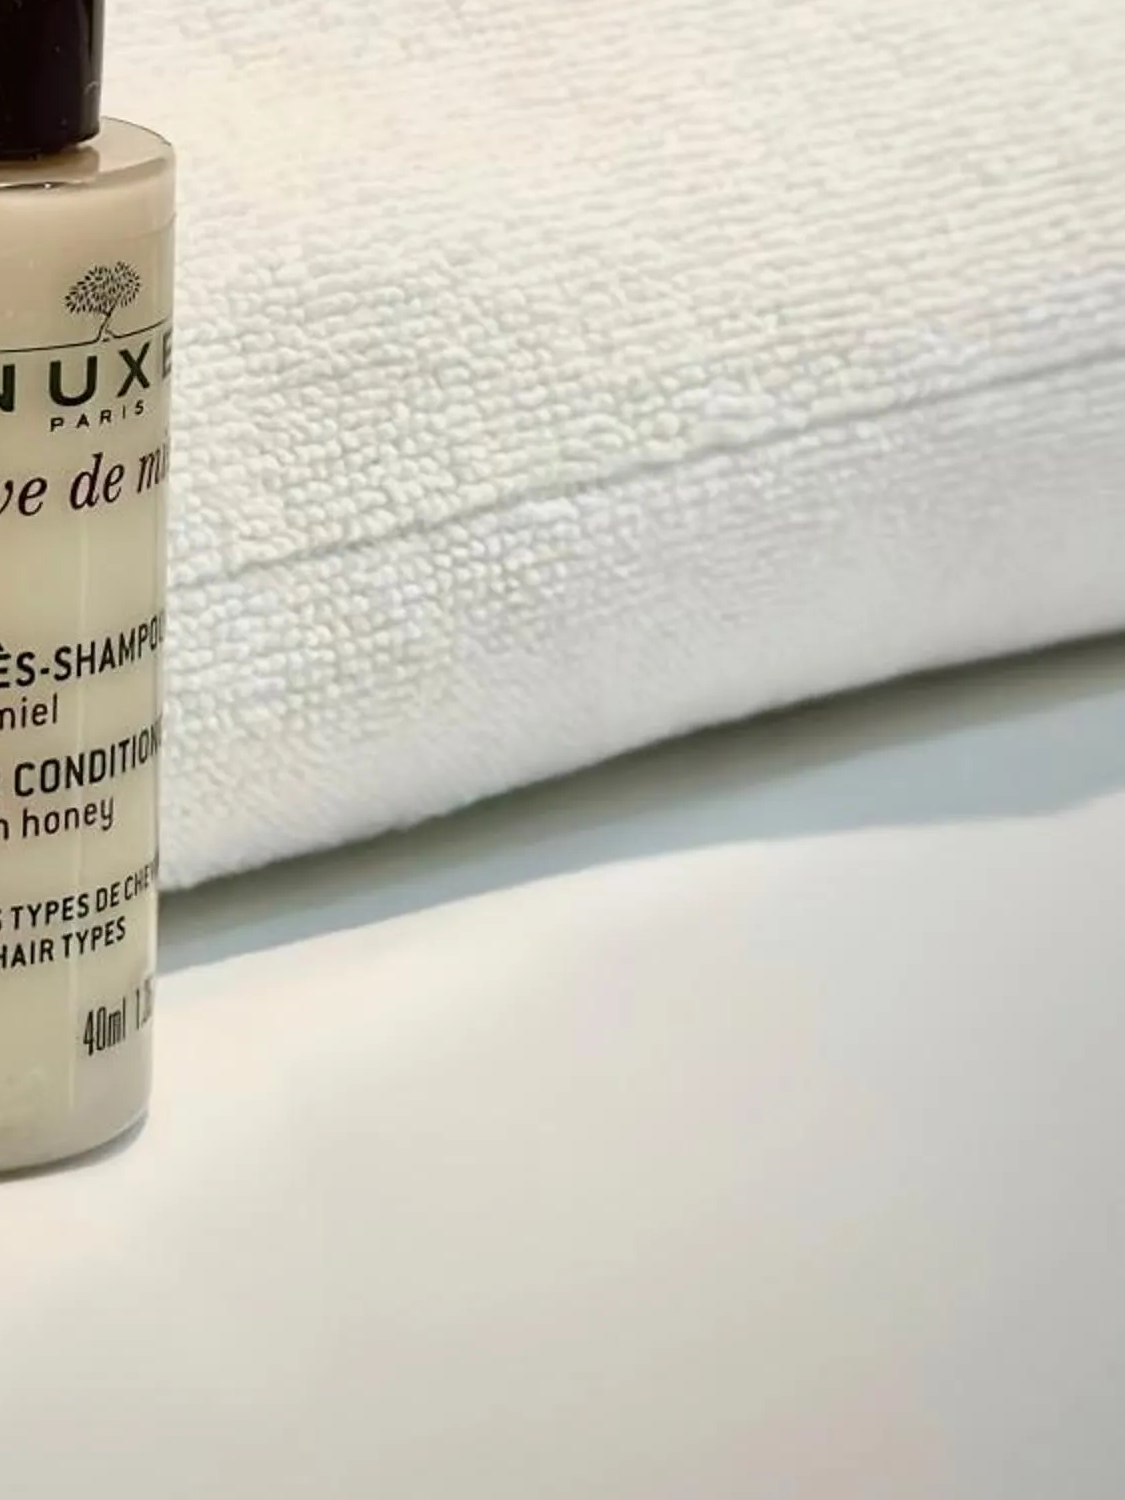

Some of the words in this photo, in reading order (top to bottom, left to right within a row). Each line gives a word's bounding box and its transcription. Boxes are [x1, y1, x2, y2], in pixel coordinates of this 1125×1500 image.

[50, 400, 144, 432] PARIS
[69, 451, 124, 511] de
[22, 797, 114, 839] honey
[10, 892, 90, 930] TYPES
[95, 881, 120, 913] DE
[62, 915, 125, 958] TYPES
[83, 996, 126, 1056] 40ml
